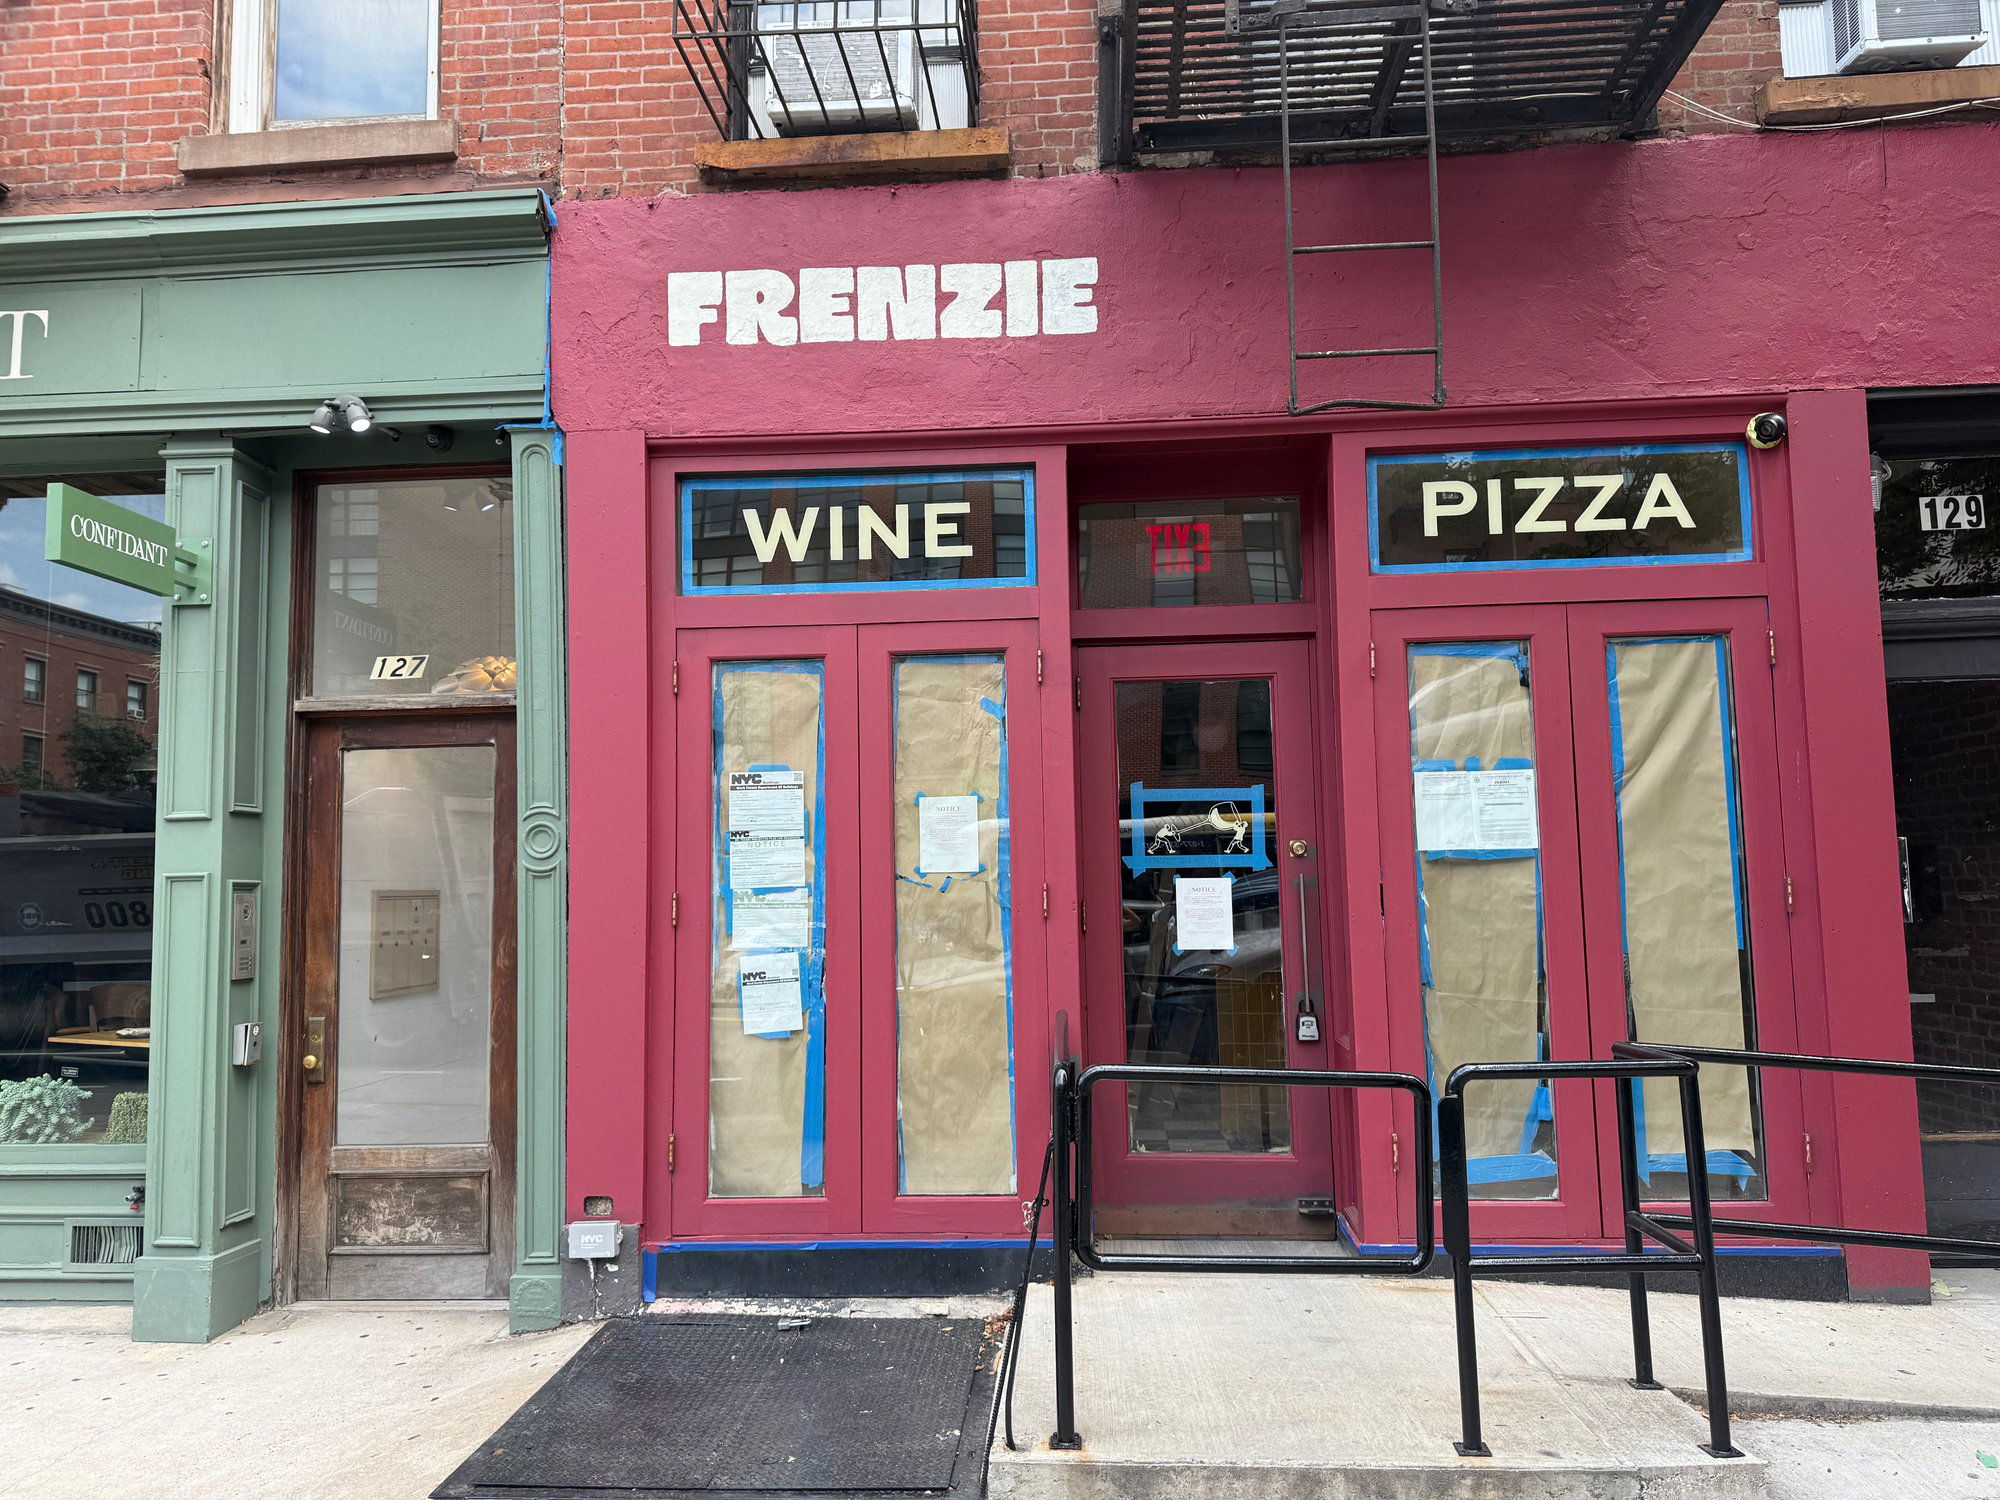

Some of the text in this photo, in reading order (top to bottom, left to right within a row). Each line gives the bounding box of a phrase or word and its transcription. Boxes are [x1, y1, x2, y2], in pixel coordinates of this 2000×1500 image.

[668, 257, 1098, 347] FRENZIE
[1422, 473, 1697, 537] PIZZA
[1924, 497, 1983, 530] 129
[70, 512, 168, 568] CONFIDANT
[742, 502, 973, 562] WINE
[377, 656, 427, 678] 127
[732, 774, 762, 784] NYC
[743, 971, 766, 981] NYC
